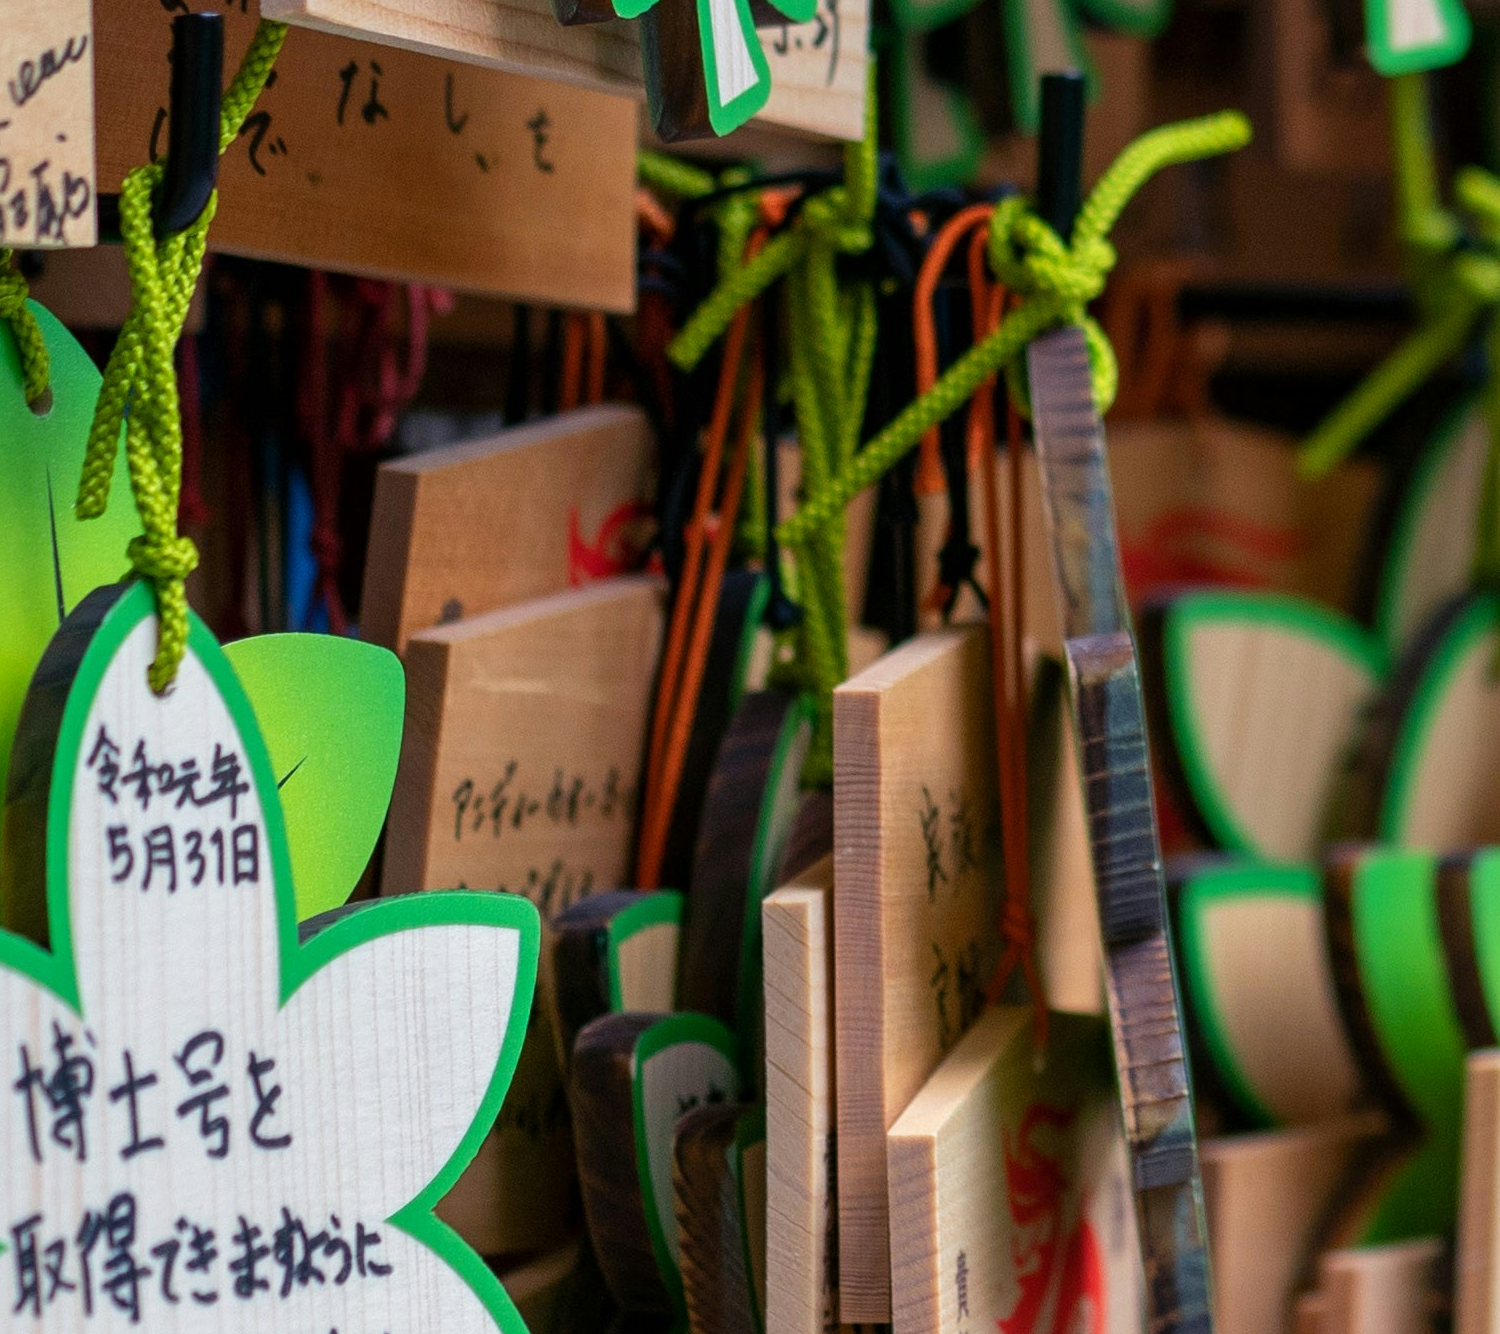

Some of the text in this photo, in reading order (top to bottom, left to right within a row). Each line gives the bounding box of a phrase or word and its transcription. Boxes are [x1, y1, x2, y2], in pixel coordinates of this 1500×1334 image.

[86, 722, 253, 817] 令和元年
[106, 821, 263, 893] 5月31日
[13, 1019, 295, 1166] 博士号を
[10, 1191, 396, 1324] 取得できますように
